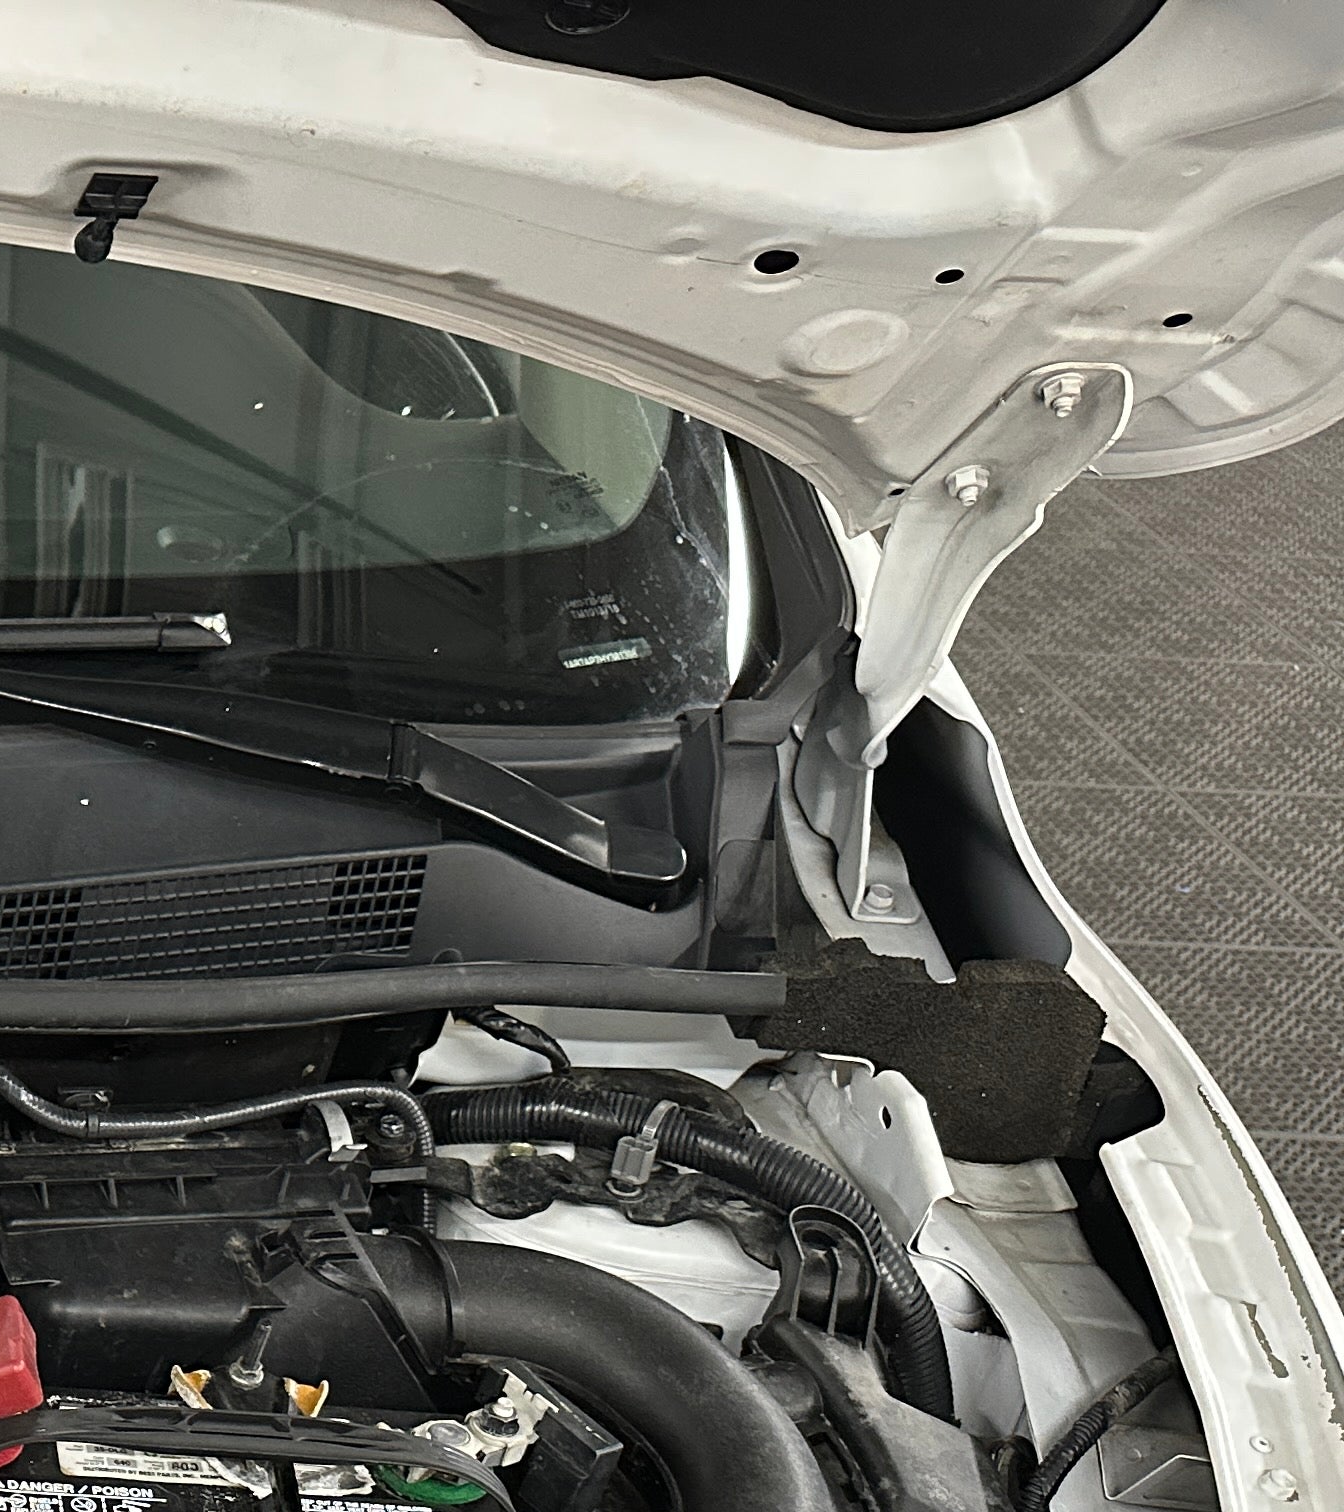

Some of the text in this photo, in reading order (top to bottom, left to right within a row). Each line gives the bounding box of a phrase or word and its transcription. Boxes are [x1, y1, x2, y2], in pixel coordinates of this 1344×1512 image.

[6, 1479, 154, 1499] DANGER / POISON
